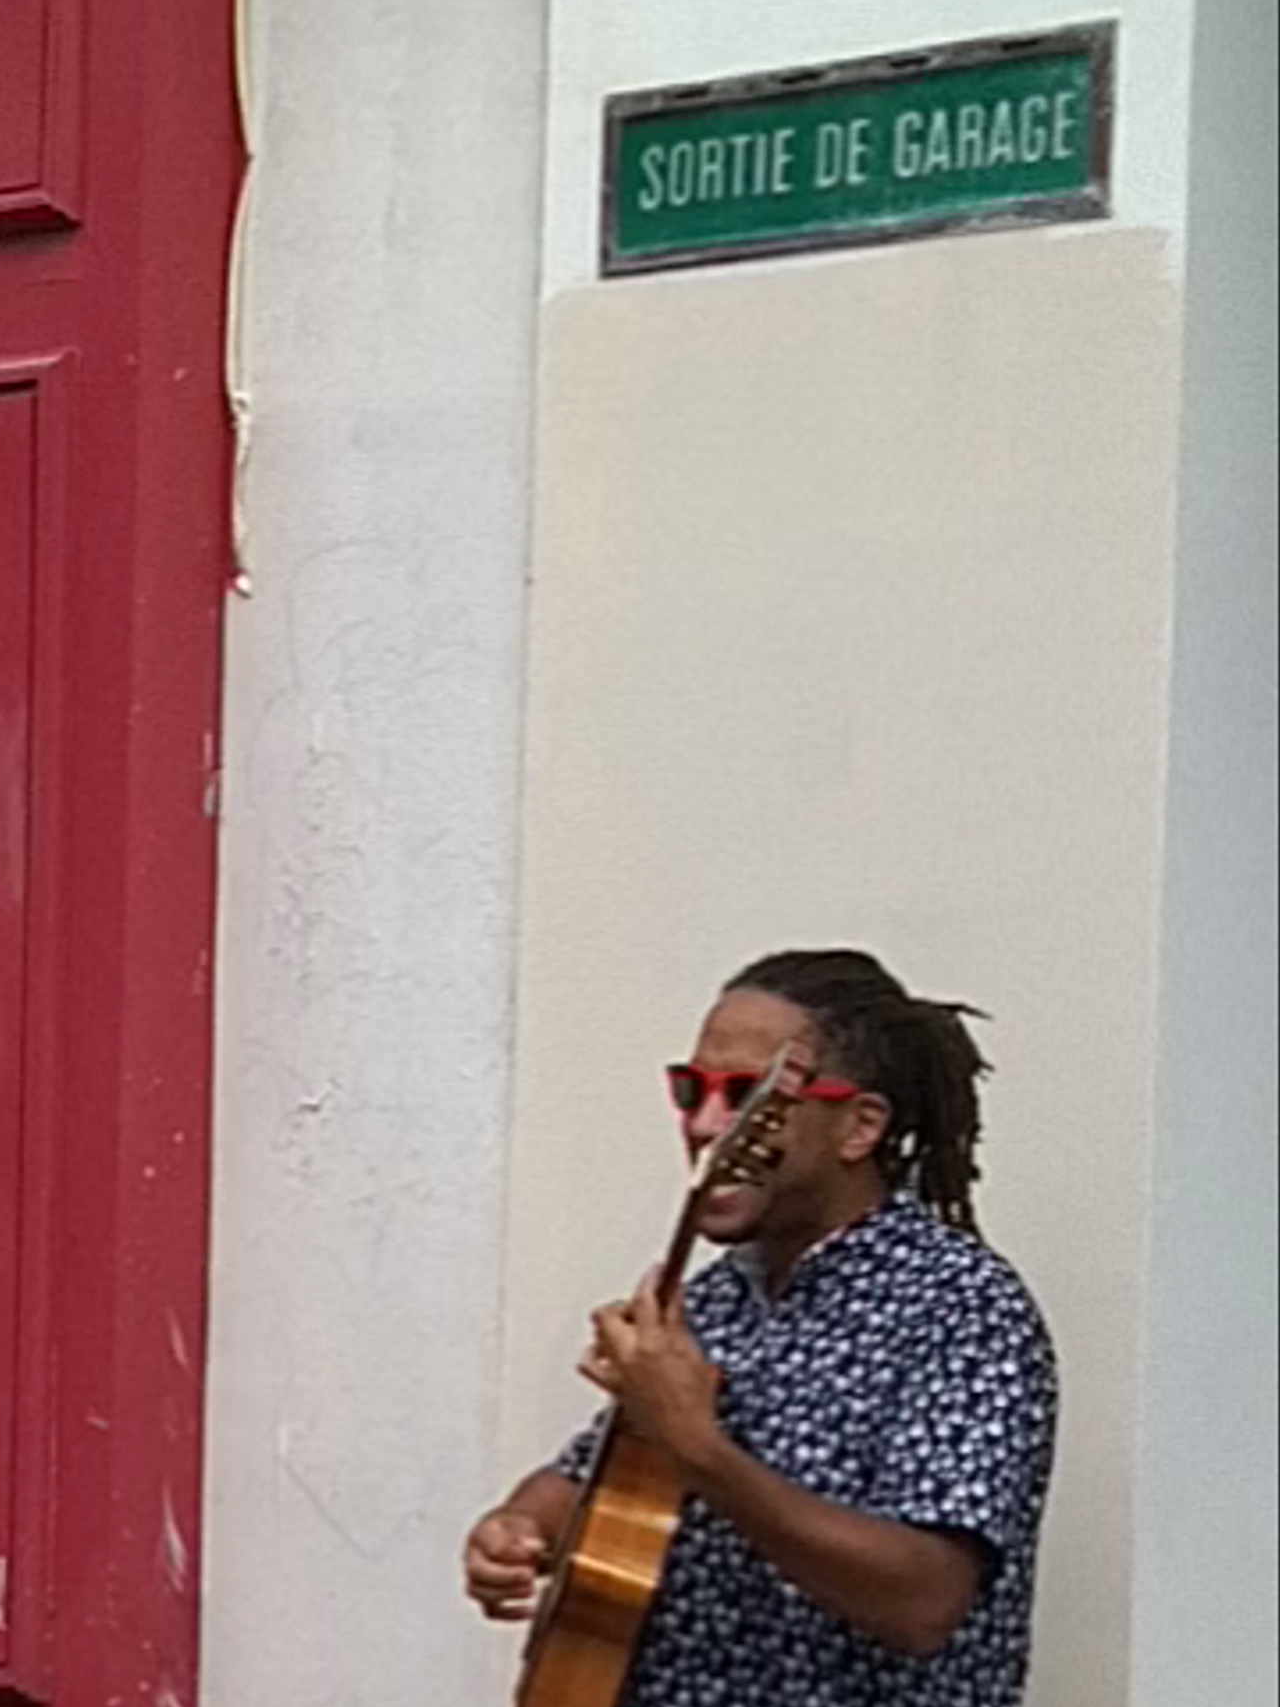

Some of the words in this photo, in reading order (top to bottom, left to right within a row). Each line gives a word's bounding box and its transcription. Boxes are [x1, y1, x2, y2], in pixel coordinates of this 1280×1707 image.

[638, 127, 796, 211] SORTIE
[815, 118, 873, 190] DE
[892, 91, 1078, 179] GARAGE
